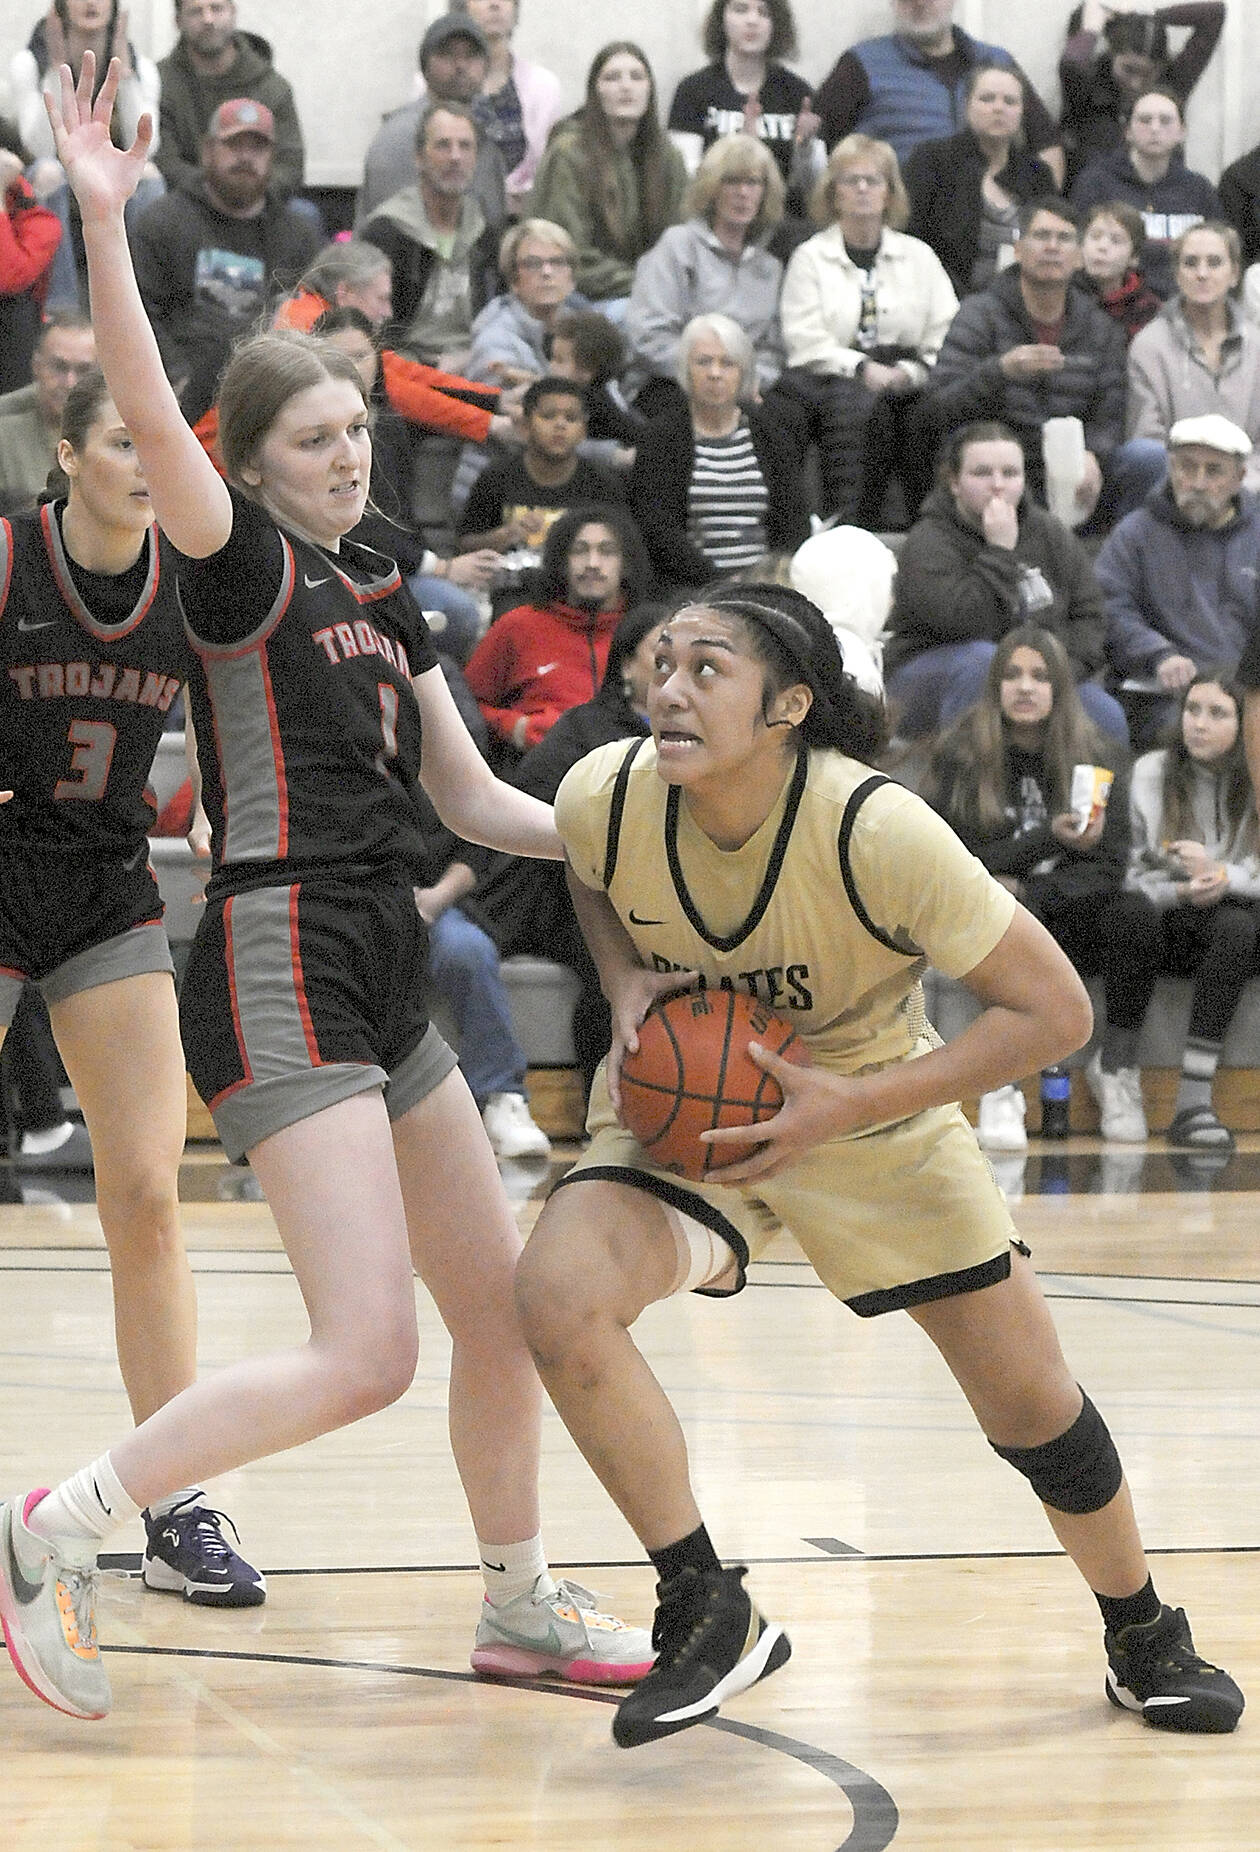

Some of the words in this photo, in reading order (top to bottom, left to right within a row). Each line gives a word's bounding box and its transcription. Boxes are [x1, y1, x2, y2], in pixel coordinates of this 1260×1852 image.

[8, 662, 180, 711] TROJANS
[312, 620, 413, 687] TROAN
[54, 719, 118, 800] 3
